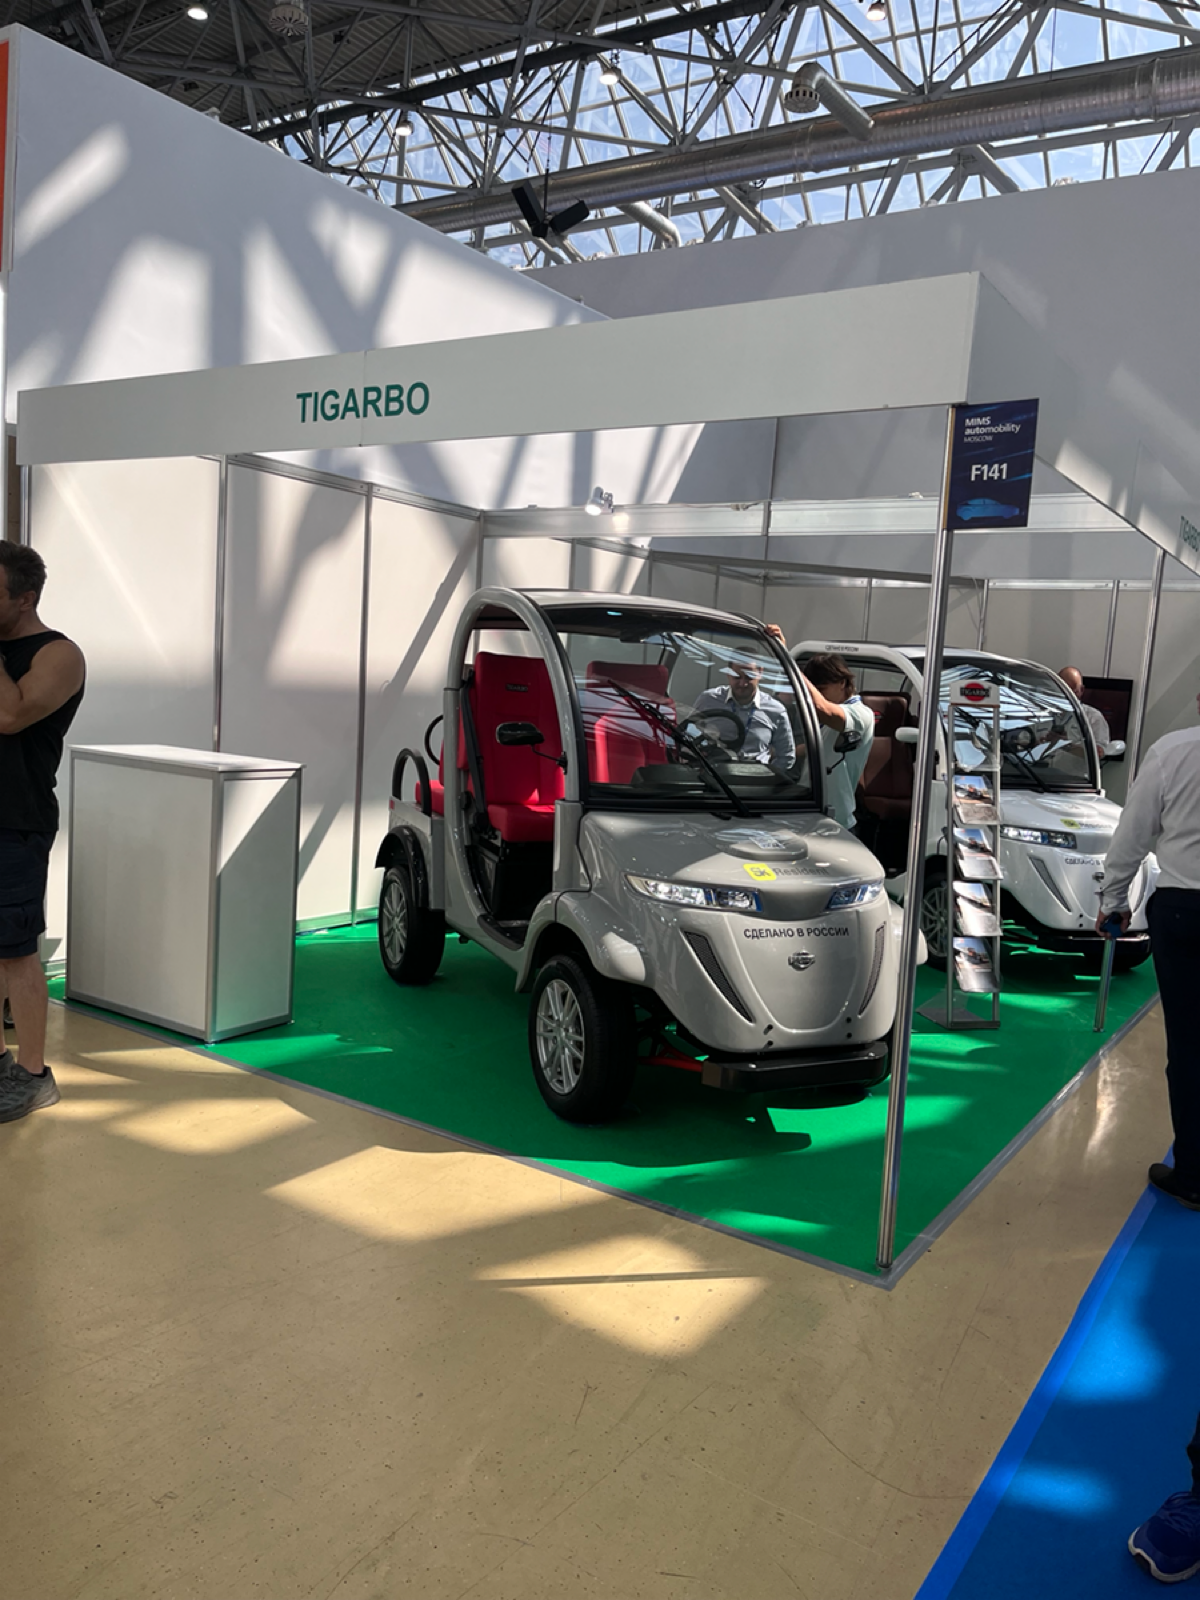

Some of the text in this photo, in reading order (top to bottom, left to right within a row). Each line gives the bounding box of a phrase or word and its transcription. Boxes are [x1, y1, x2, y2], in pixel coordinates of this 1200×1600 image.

[296, 381, 430, 424] TIGARBO
[964, 416, 991, 427] MIMS
[964, 423, 1021, 435] automobility
[963, 435, 993, 443] MOSCOW
[971, 463, 1008, 481] F141
[772, 867, 829, 876] Resident
[743, 927, 849, 939] СДЕЛАНО В РОССИИ
